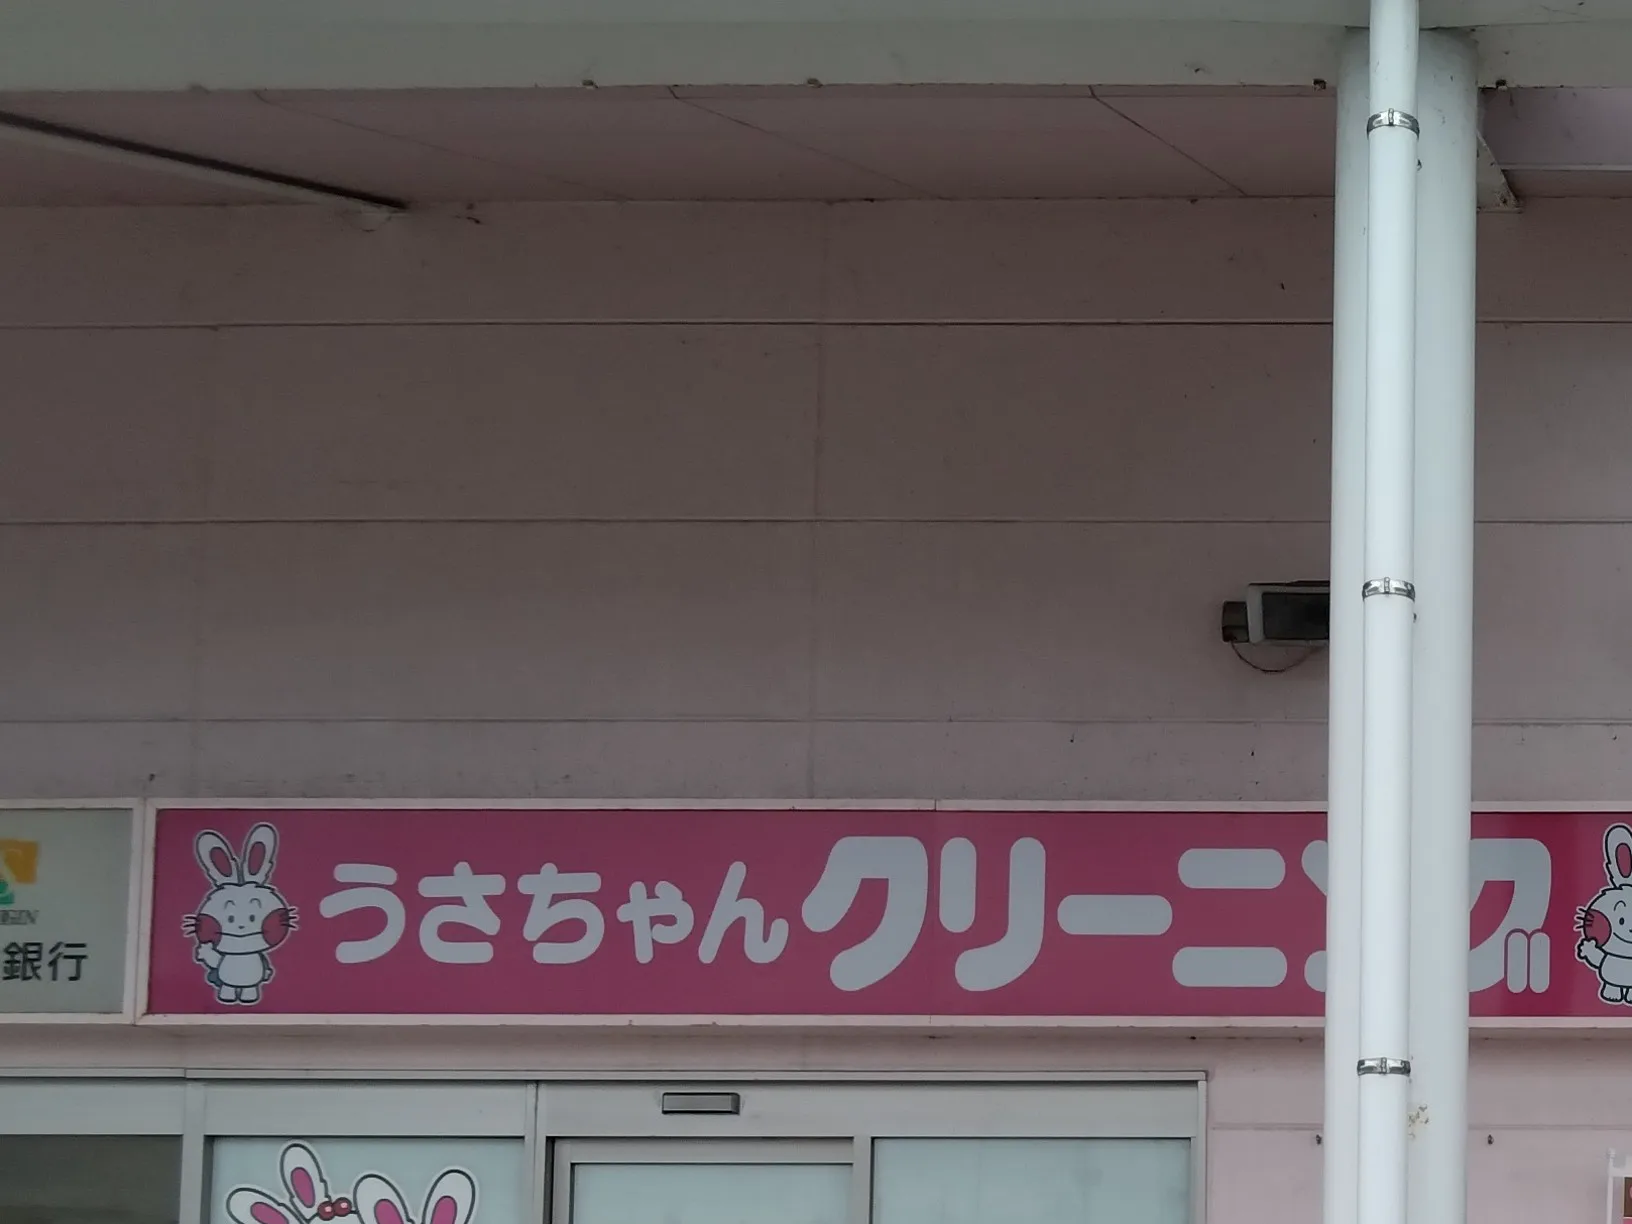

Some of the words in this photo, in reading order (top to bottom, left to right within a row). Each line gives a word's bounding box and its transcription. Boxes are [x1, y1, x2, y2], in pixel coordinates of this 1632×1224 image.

[2, 941, 88, 982] 銀行
[319, 835, 1552, 996] うさちゃんクリーニグ
